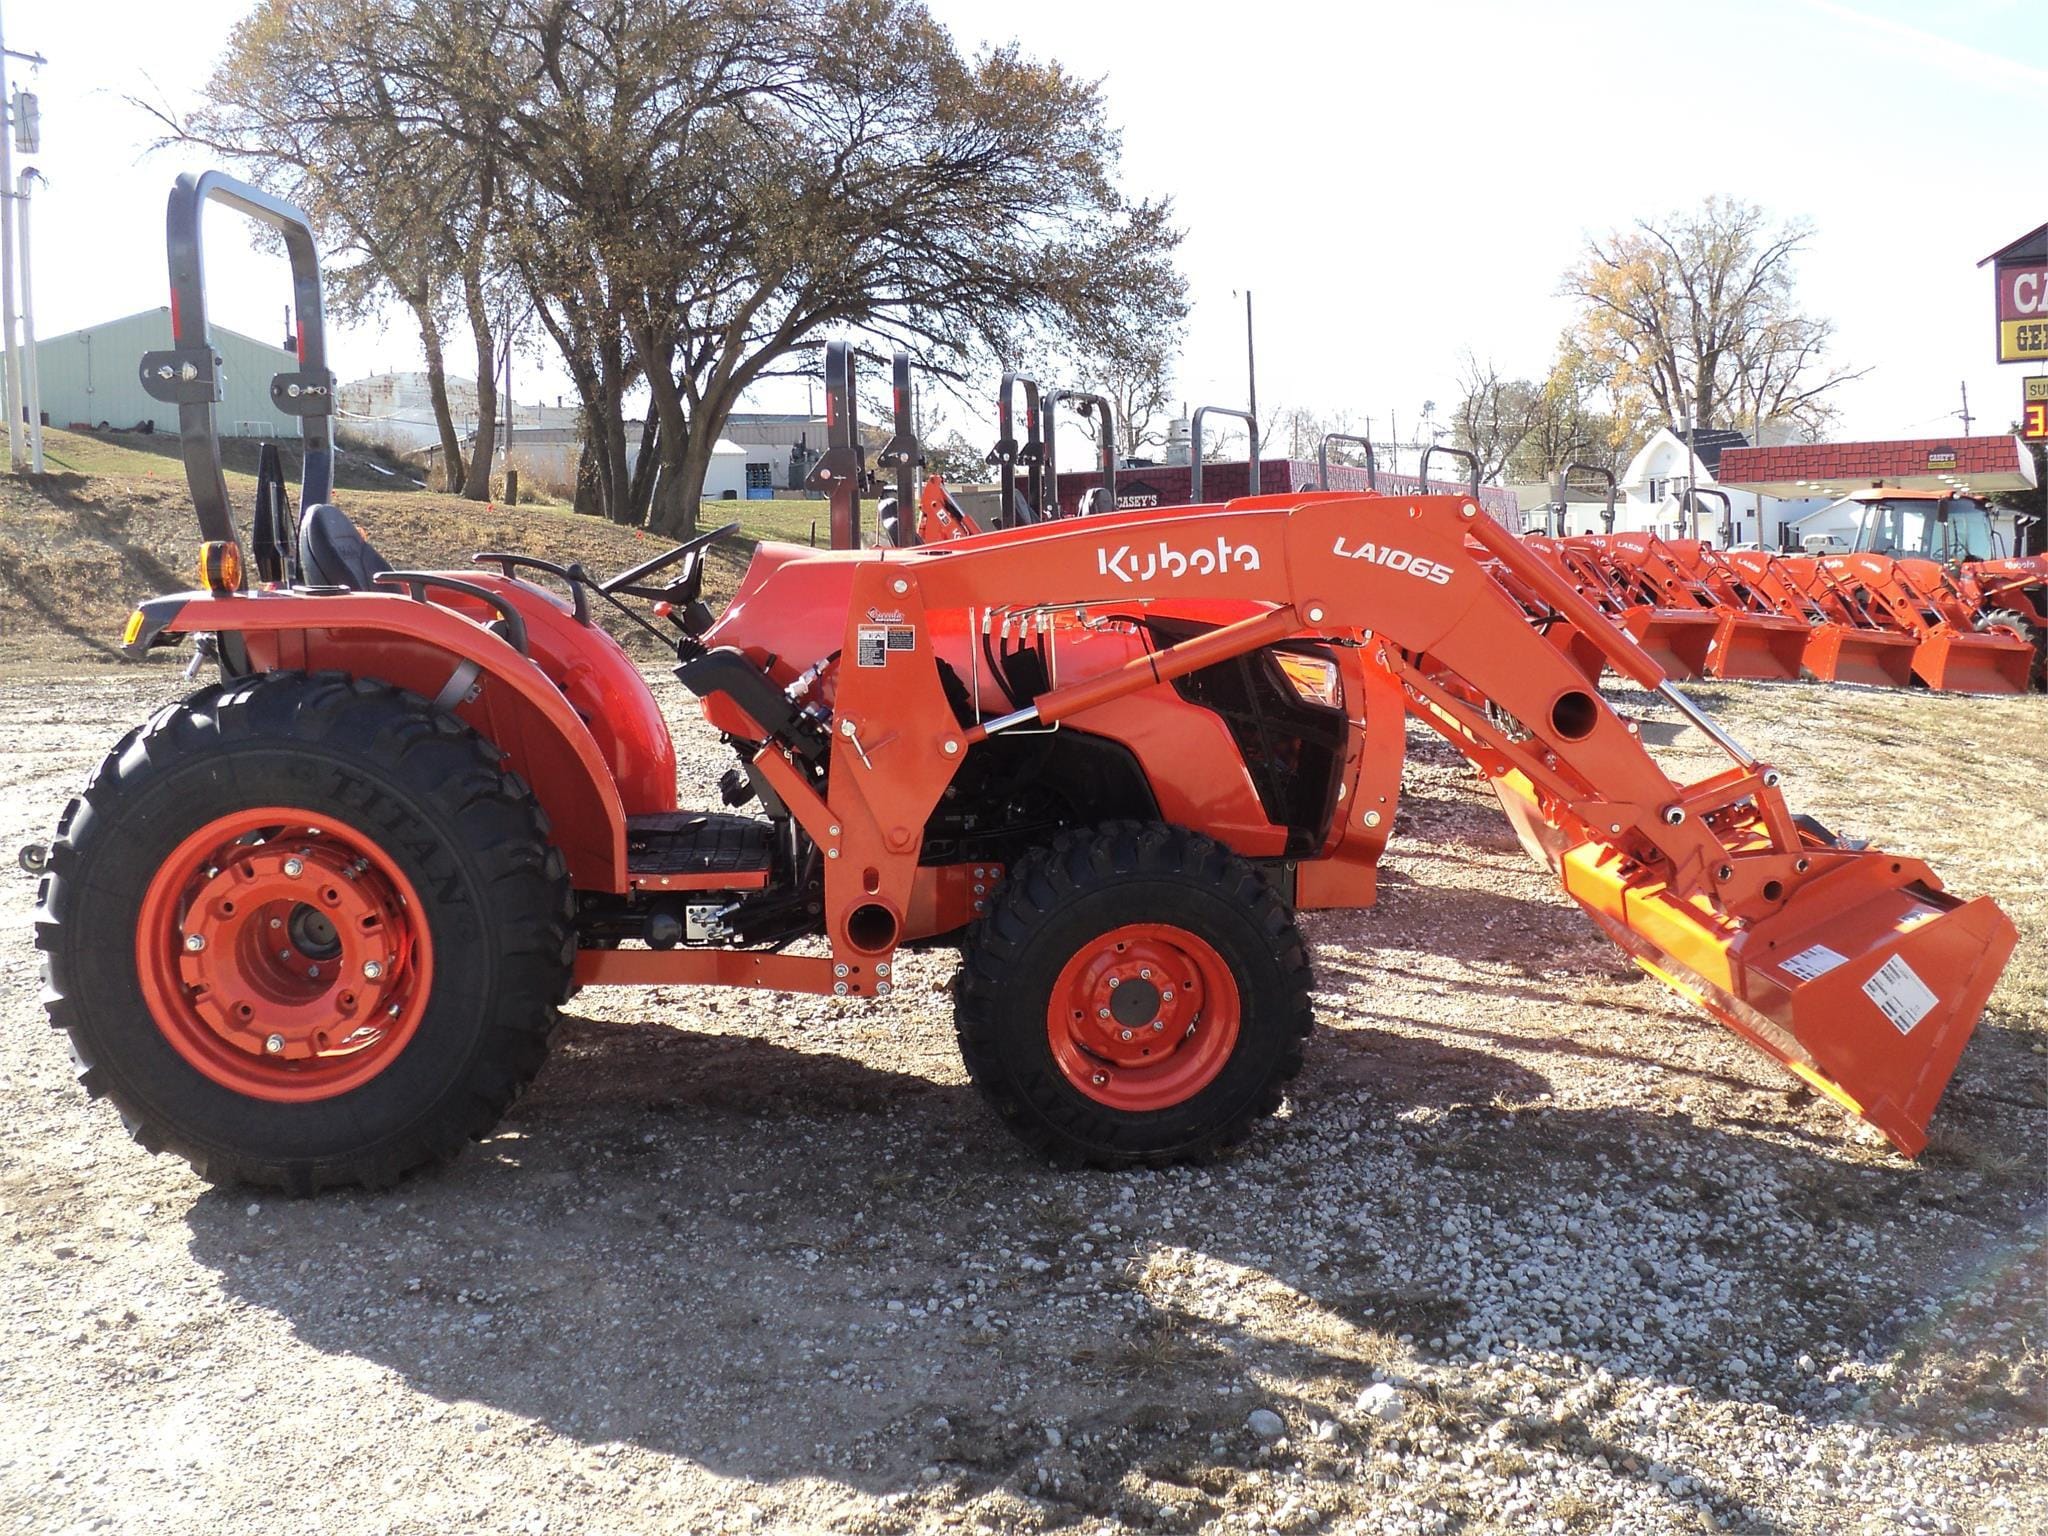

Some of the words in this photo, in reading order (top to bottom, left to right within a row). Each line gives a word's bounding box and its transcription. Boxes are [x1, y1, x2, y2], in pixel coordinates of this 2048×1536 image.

[1117, 495, 1158, 510] CASEY'S
[1097, 536, 1261, 583] Kubota
[1332, 536, 1454, 585] LA1065
[328, 766, 472, 906] TITAN
